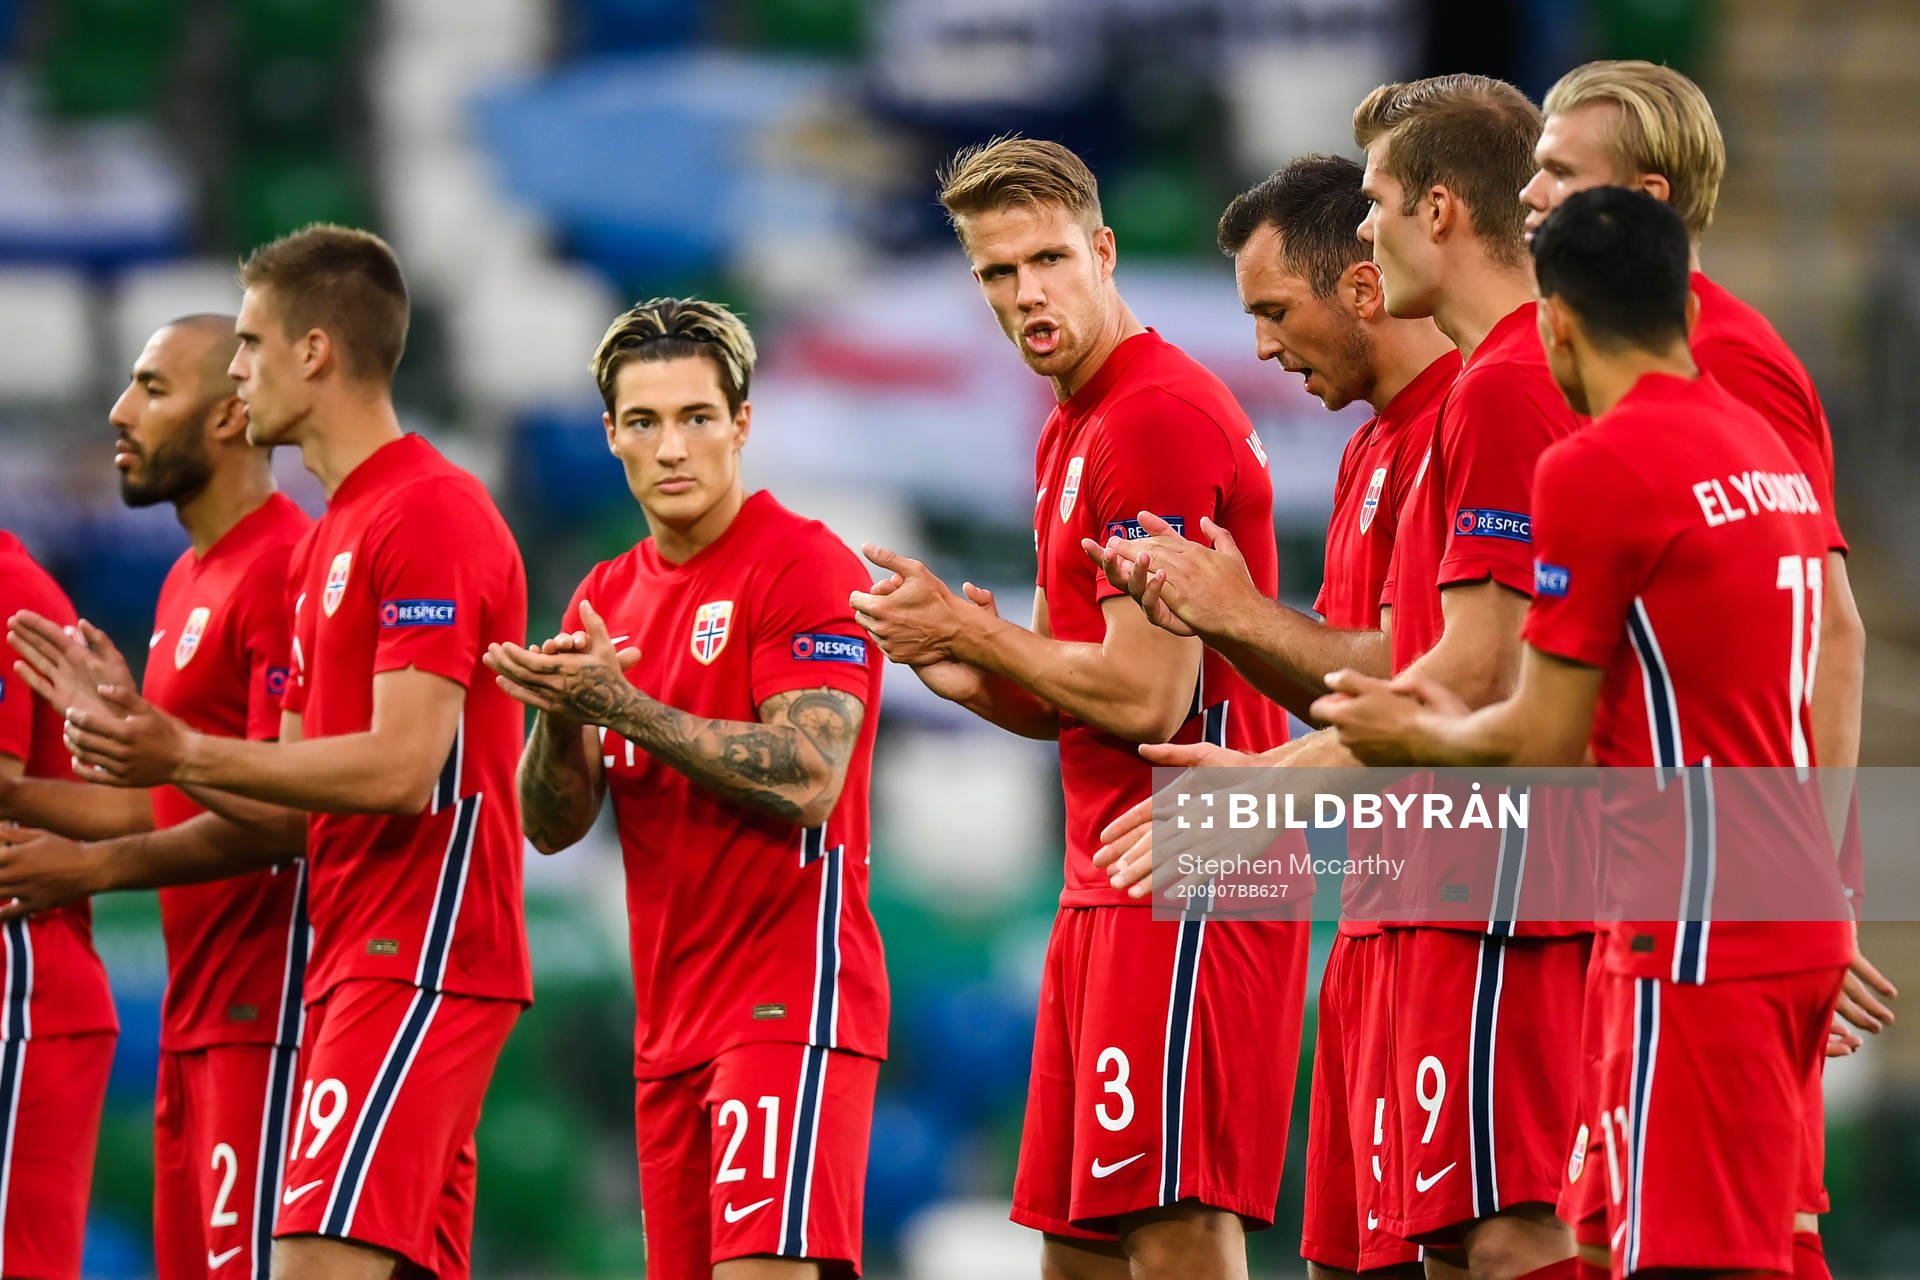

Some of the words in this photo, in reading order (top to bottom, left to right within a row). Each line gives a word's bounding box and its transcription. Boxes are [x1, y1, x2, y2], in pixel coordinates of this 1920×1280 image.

[1477, 516, 1531, 535] RESPEC
[398, 605, 454, 620] RESPECT
[815, 641, 865, 658] RESPECT
[1776, 555, 1822, 784] 11
[290, 1077, 348, 1161] 19
[1095, 1046, 1135, 1131] 3
[1416, 1055, 1447, 1144] 9
[715, 1095, 780, 1184] 21
[211, 1142, 238, 1228] 2
